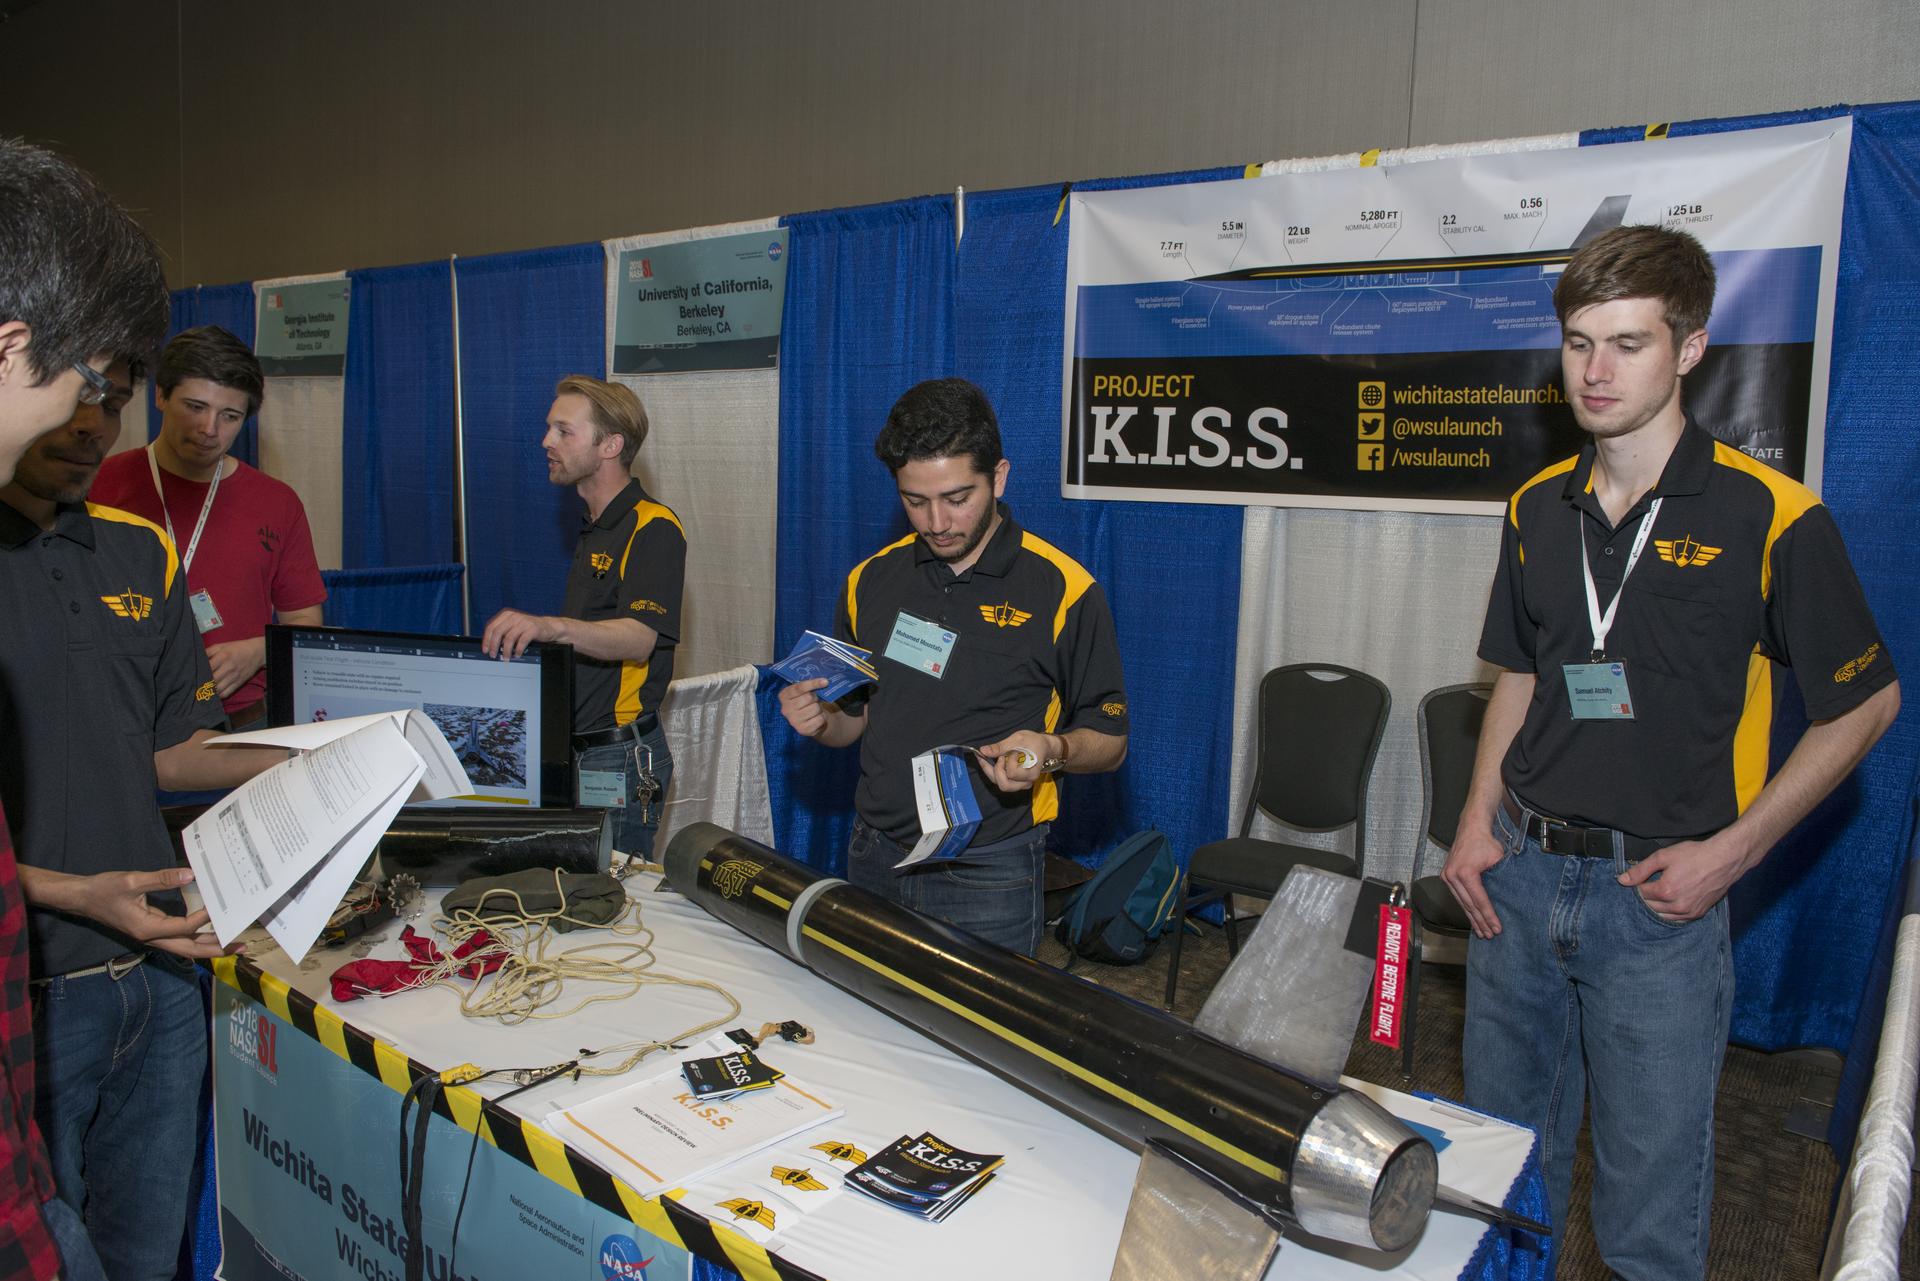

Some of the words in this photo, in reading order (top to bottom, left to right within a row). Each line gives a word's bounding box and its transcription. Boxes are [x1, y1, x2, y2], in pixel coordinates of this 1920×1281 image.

[1520, 197, 1542, 209] 0.56
[1667, 204, 1687, 216] 125
[1689, 205, 1702, 214] LB
[1360, 210, 1385, 222] 5,280
[1387, 211, 1398, 220] FT
[1442, 215, 1456, 225] 2.2
[1522, 210, 1542, 219] MACH
[1685, 214, 1713, 224] THRUST
[1222, 221, 1234, 231] 5.5
[1235, 222, 1243, 231] IN
[1288, 226, 1298, 236] 22
[1300, 227, 1310, 235] LB
[1344, 223, 1372, 232] NOMINAL
[1373, 221, 1398, 230] APOGEE
[1443, 225, 1472, 235] STABILITY
[1217, 232, 1244, 240] DIAMETER
[1287, 237, 1309, 245] WEIGHT
[1160, 241, 1173, 250] 7.7
[1174, 242, 1184, 250] FT
[1162, 250, 1183, 258] Length
[638, 285, 688, 302] University
[691, 283, 700, 296] of
[704, 276, 773, 296] California,
[284, 314, 307, 326] Georgia
[308, 312, 335, 323] Institute
[679, 304, 725, 319] Berkeley
[288, 329, 295, 339] of
[296, 329, 330, 339] Technology
[677, 323, 715, 337] Berkeley,
[717, 322, 731, 334] CA
[1093, 375, 1195, 397] PROJECT
[1393, 384, 1570, 405] wichitastatelaunch.
[1392, 416, 1502, 440] @wsulaunch
[1088, 406, 1303, 470] K.I.S.S.
[1391, 448, 1490, 467] /wsulaunch
[895, 628, 920, 644] Mohamed
[1384, 921, 1401, 963] REMOVE
[1381, 963, 1398, 1001] BEFORE
[230, 998, 258, 1033] 2018
[258, 1014, 278, 1074] SL
[230, 1022, 258, 1060] NASA
[229, 1044, 256, 1069] Student
[673, 1092, 734, 1130] K.I.S.S.
[633, 1105, 661, 1126] PRELIMINARY
[660, 1124, 678, 1138] DESIGN
[677, 1135, 697, 1149] REVIEW
[924, 1136, 954, 1154] Project
[907, 1141, 983, 1173] K.I.S.S.
[243, 1107, 332, 1205] Wichita
[341, 1183, 410, 1264] State
[509, 1194, 534, 1216] National
[534, 1210, 571, 1238] Aeronautics
[572, 1231, 585, 1246] and
[518, 1212, 538, 1232] Space
[538, 1225, 585, 1257] Administration
[603, 1252, 644, 1281] NASA
